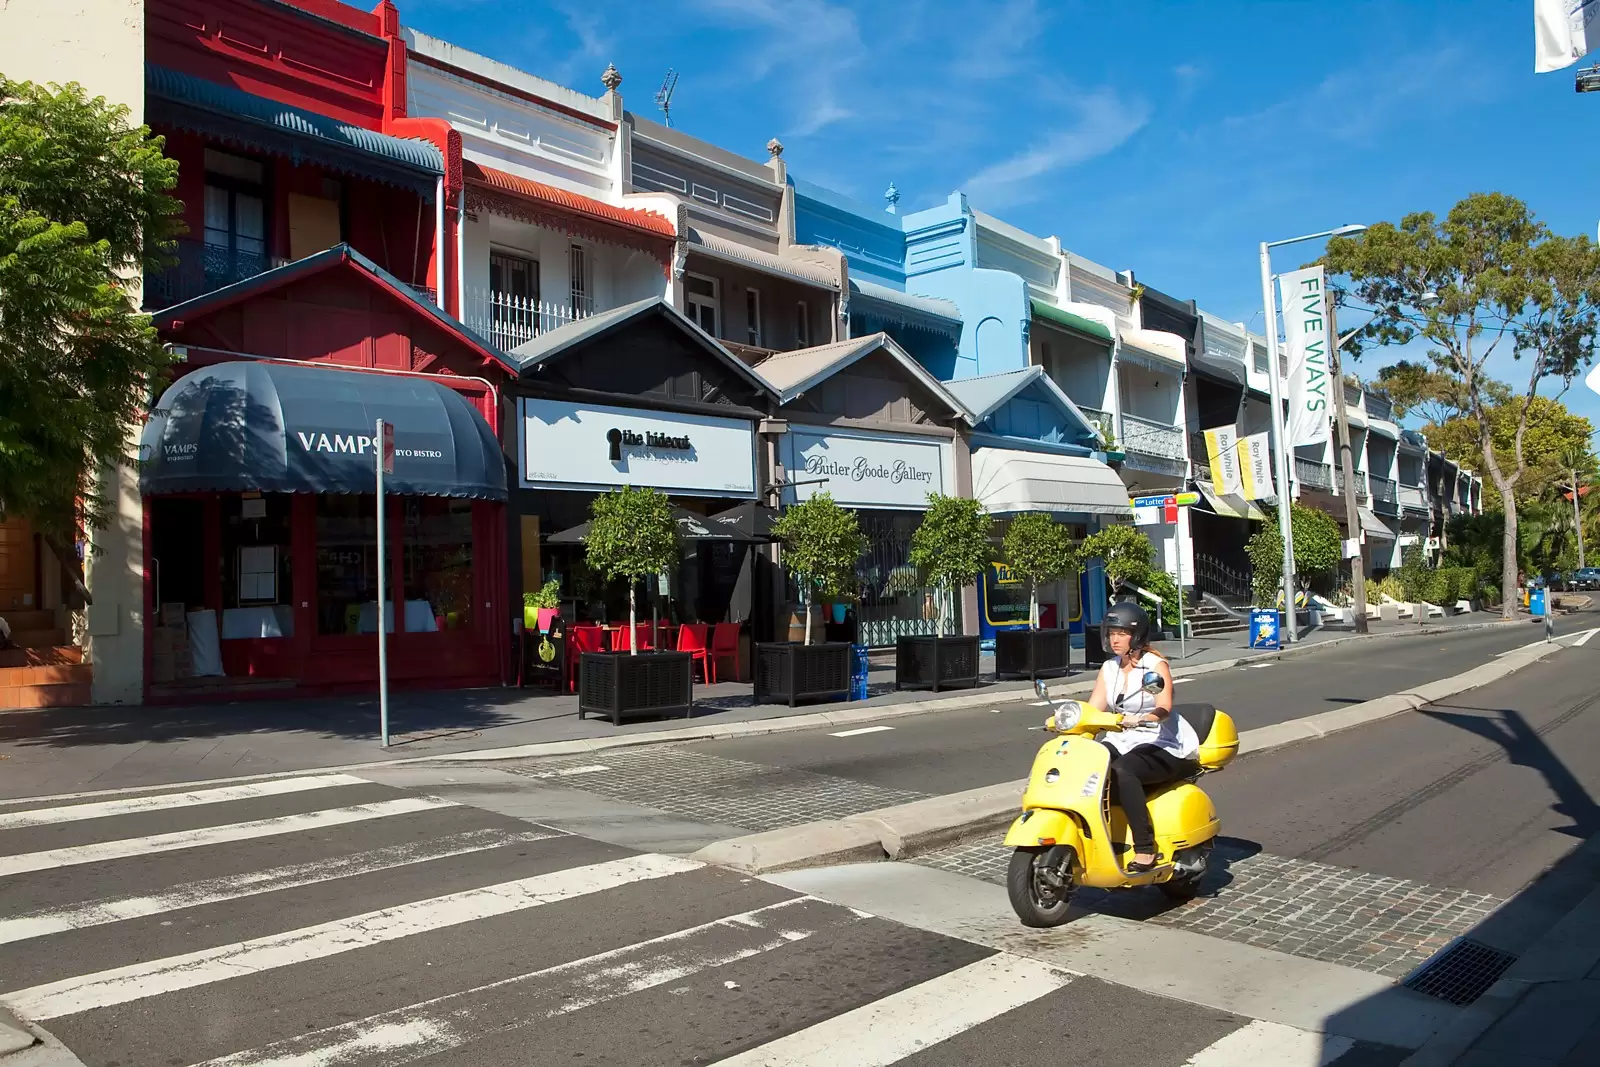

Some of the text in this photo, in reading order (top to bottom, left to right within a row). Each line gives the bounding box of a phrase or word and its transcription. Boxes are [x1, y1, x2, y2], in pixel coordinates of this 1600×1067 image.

[1300, 277, 1326, 413] FIVE WAYS
[163, 443, 198, 454] VAMPS
[395, 449, 412, 457] BYO
[413, 449, 442, 458] BISTRO
[622, 429, 691, 450] the hideout
[805, 455, 932, 484] Butler Goode Gallery
[1219, 434, 1233, 479] Ray White
[1251, 441, 1264, 485] Ray White
